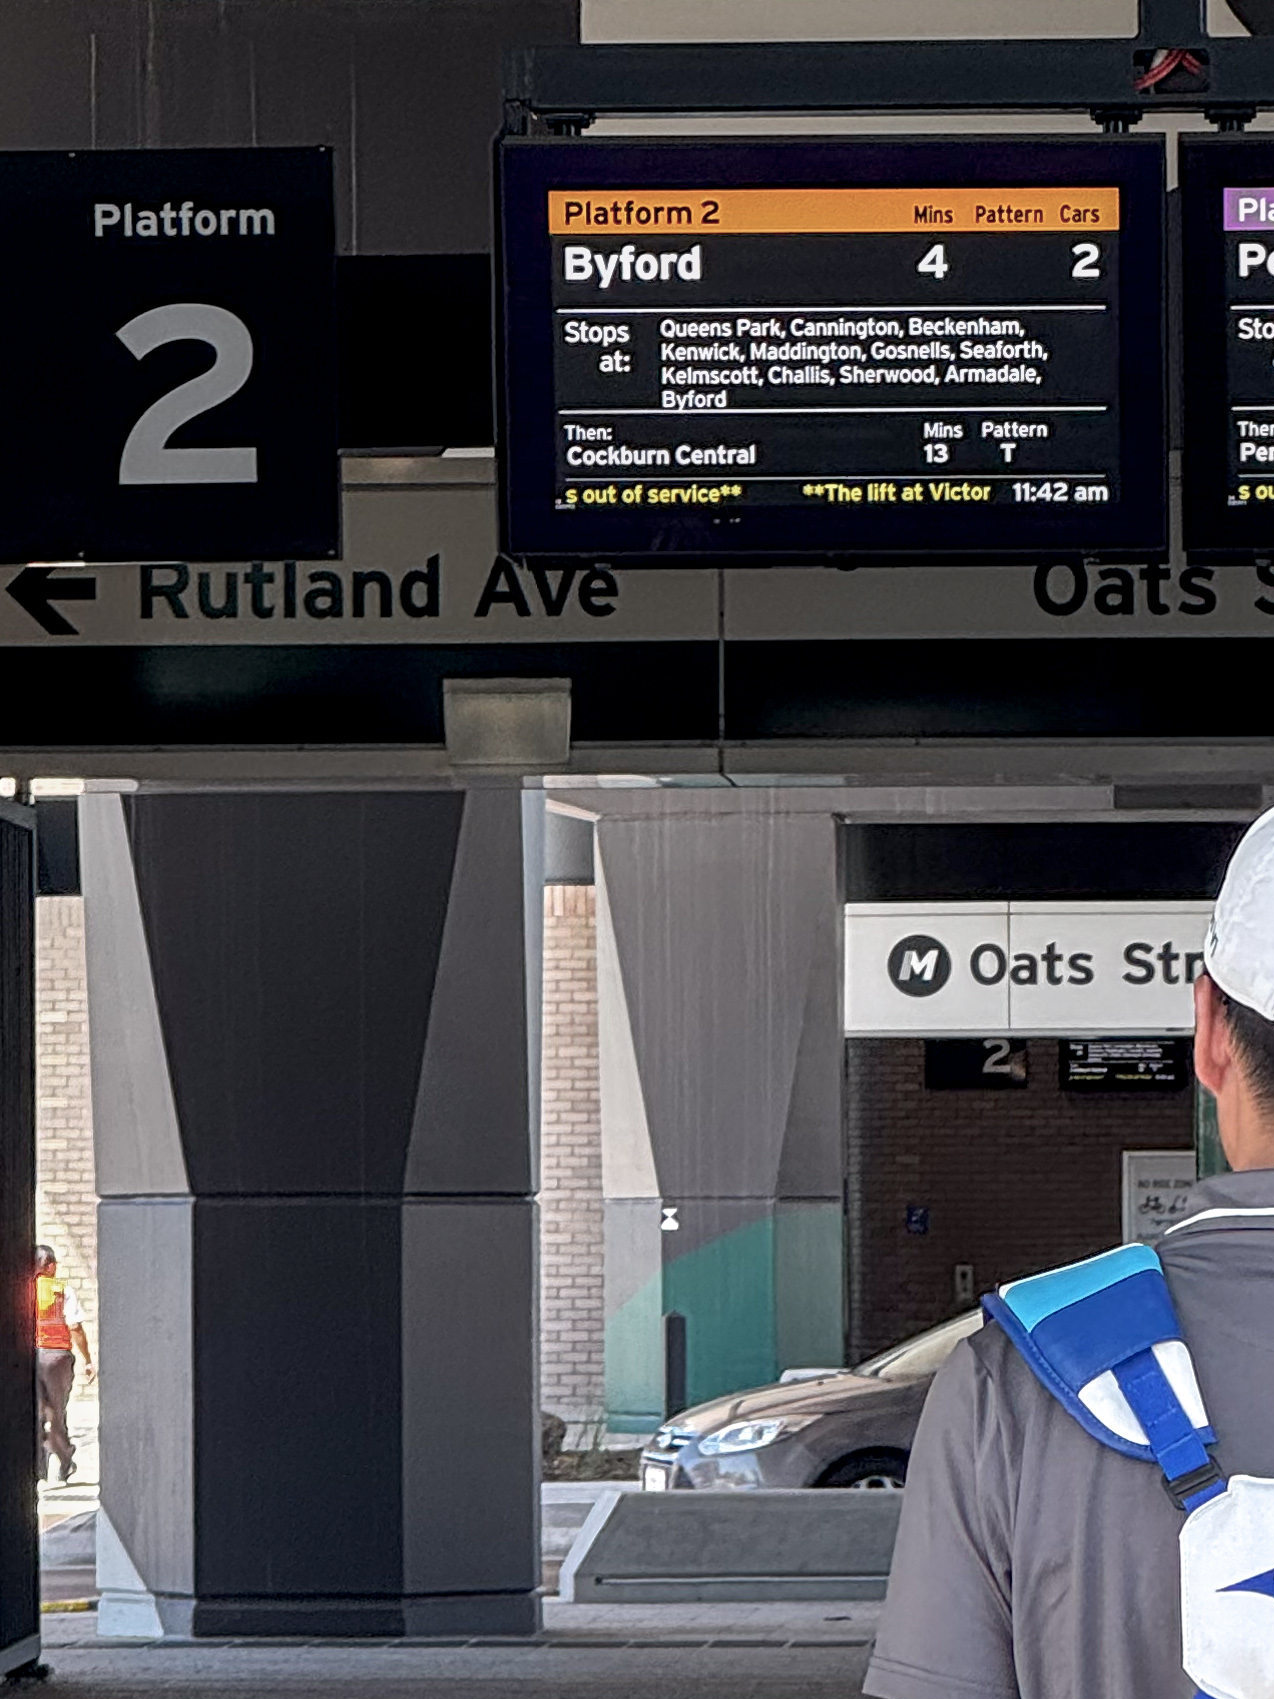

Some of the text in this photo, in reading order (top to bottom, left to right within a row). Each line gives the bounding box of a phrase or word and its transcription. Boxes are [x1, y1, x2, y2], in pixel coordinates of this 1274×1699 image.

[94, 201, 275, 237] Platform
[564, 200, 720, 226] Platform 2
[913, 204, 1100, 224] Mins Pattern Cars
[564, 243, 1100, 289] Byford 4 2
[564, 320, 630, 347] Stops
[659, 317, 1025, 340] Queens Park, Cannington, Beckenham,
[599, 349, 631, 373] at:
[661, 340, 1049, 364] Kenwick, Maddington, Gosnells, Seaforth,
[661, 363, 1042, 387] Kelmscott, Challis, Sherwood, Armadale,
[115, 302, 258, 485] 2
[661, 389, 727, 408] Byford
[563, 424, 613, 441] Then:
[923, 421, 1048, 439] Mins Pattern
[566, 442, 1017, 466] Cockburn Central 13 T
[565, 488, 578, 504] s
[582, 485, 617, 504] out
[621, 484, 643, 504] of
[867, 482, 897, 502] lift
[901, 482, 924, 502] at
[928, 482, 991, 501] Victor
[1012, 481, 1109, 502] 11:42 am
[1238, 485, 1251, 500] s
[139, 552, 619, 619] Rutland Ave
[1033, 564, 1217, 617] Oats
[970, 942, 1094, 986] Oats
[1122, 941, 1205, 985] Str
[982, 1038, 1012, 1074] 2
